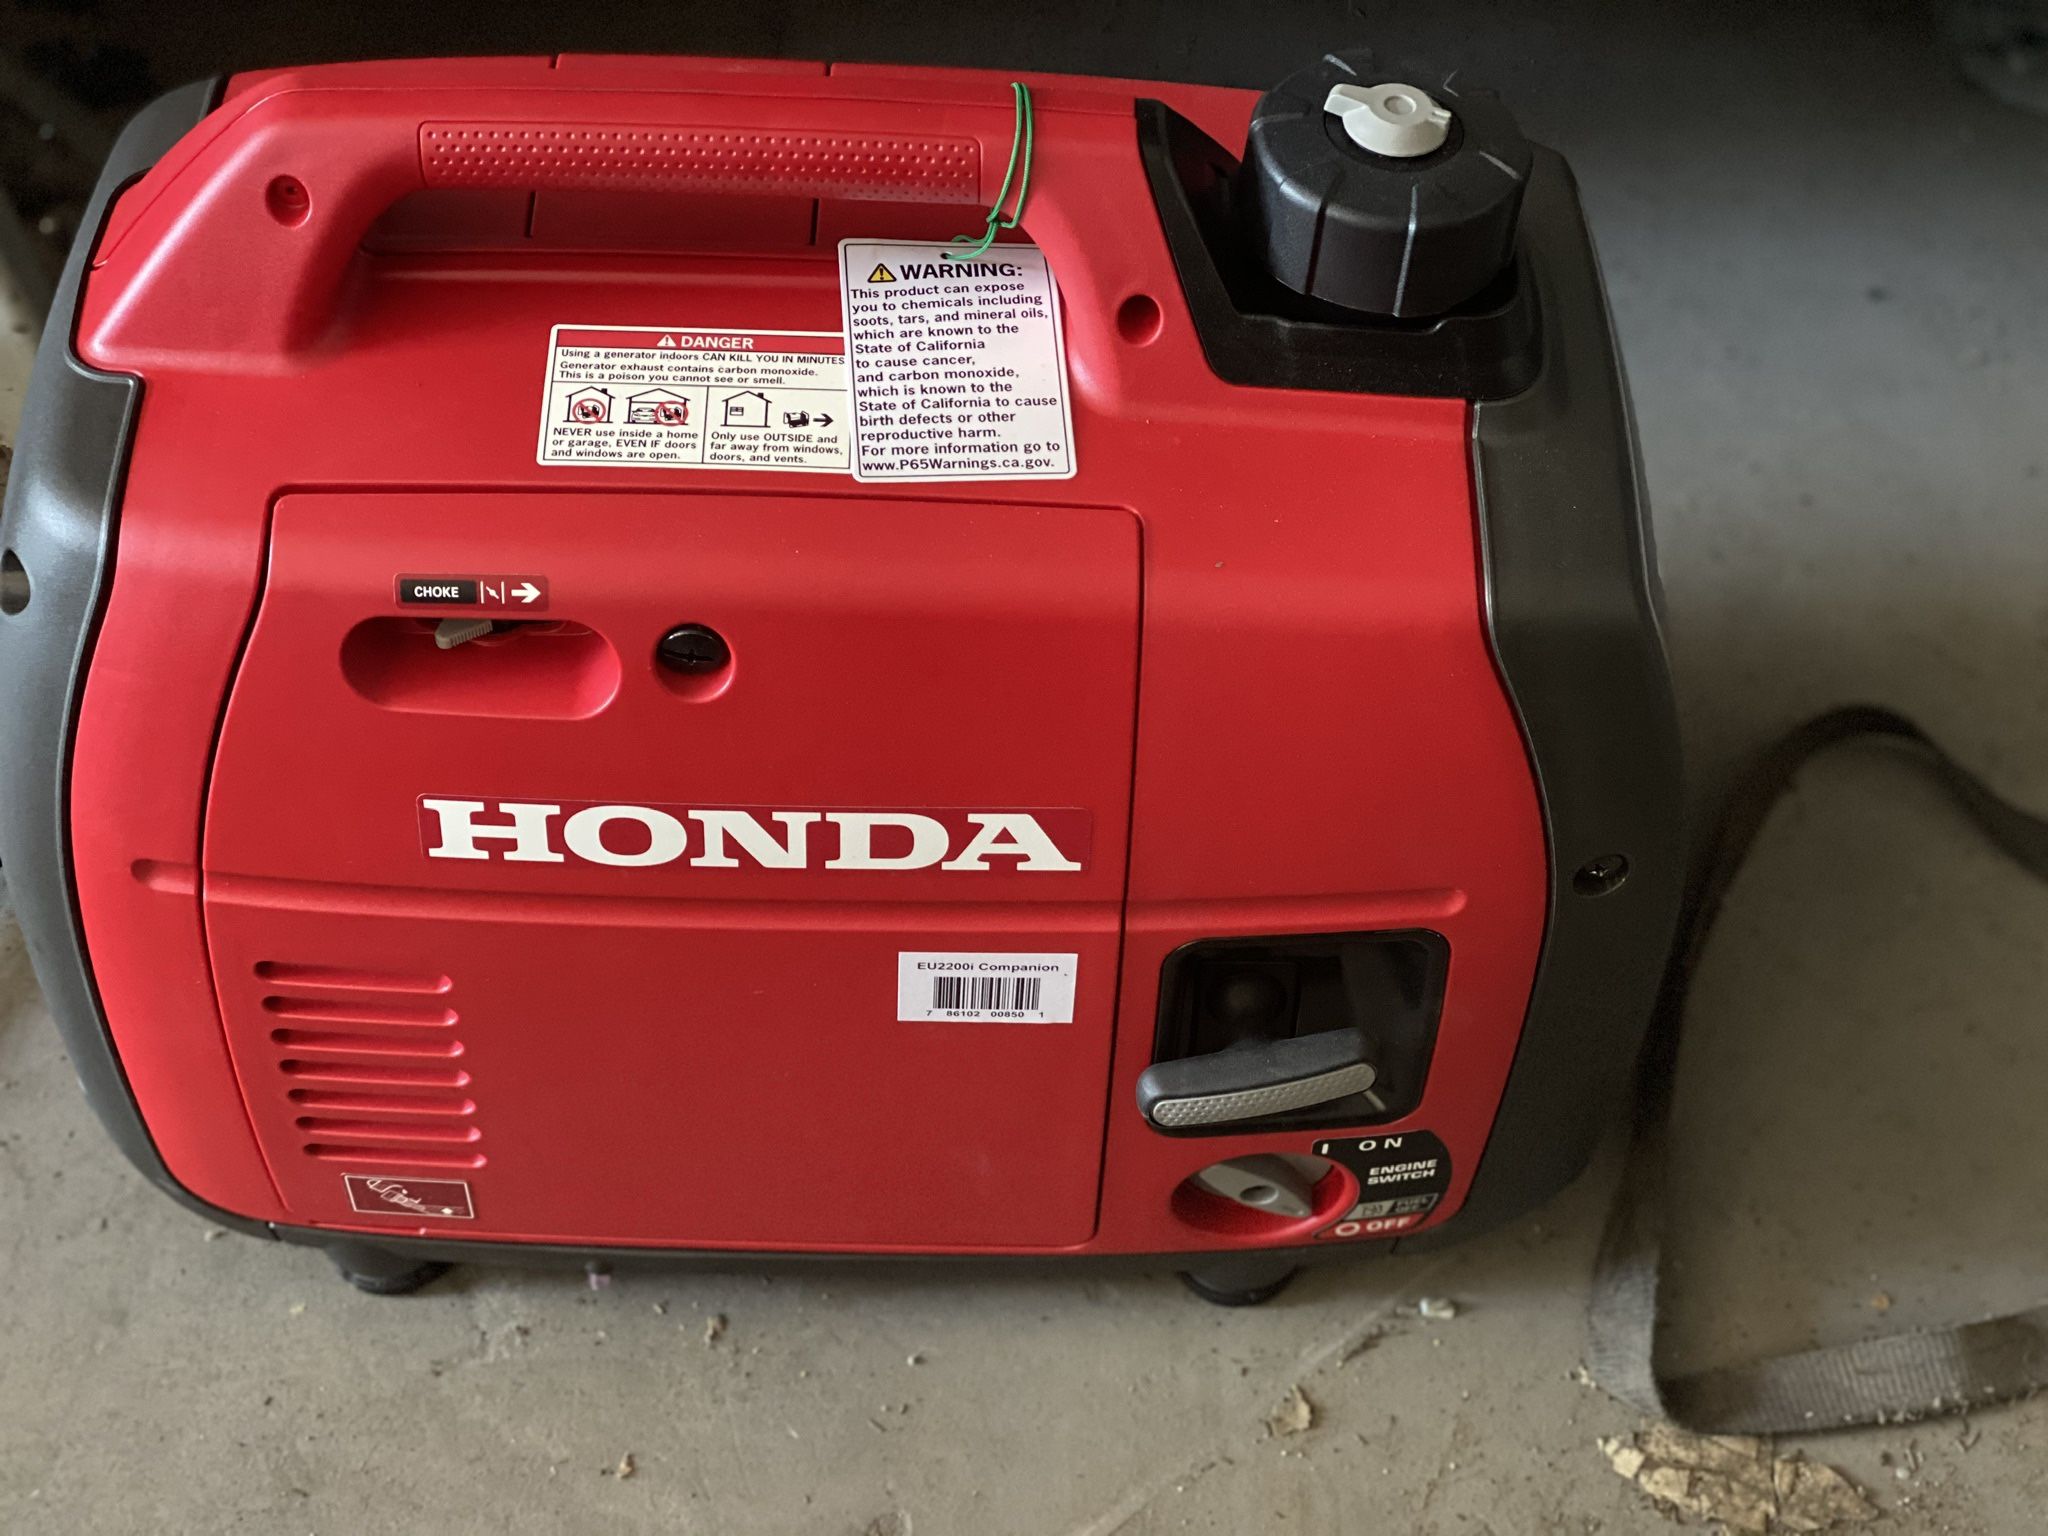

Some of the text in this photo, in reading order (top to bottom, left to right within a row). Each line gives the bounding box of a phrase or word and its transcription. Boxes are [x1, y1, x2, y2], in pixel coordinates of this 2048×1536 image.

[900, 263, 1022, 280] WARNING:
[851, 283, 1024, 299] This product can expose
[852, 294, 1042, 314] you to chemicals including
[853, 308, 1048, 326] soots, tars, and mineral oils,
[854, 324, 1018, 340] which are known to the
[680, 335, 754, 349] DANGER
[855, 339, 985, 354] State of California
[561, 349, 590, 358] Using
[604, 350, 656, 360] generator
[660, 351, 699, 360] indoors
[729, 354, 752, 362] KILL
[856, 356, 975, 368] to cause cancer,
[560, 361, 616, 370] Generator
[668, 365, 714, 373] contains
[718, 365, 758, 374] carbon
[761, 367, 818, 376] monoxide.
[858, 367, 1019, 382] and carbon monoxide,
[609, 372, 645, 381] poison
[858, 382, 1012, 397] which is known to the
[859, 397, 1057, 411] State of California to cause
[860, 411, 1016, 426] birth defects or other
[553, 428, 592, 436] NEVER
[619, 429, 652, 438] inside
[667, 430, 698, 439] home
[711, 431, 736, 440] Only
[764, 433, 813, 443] OUTSIDE
[817, 435, 838, 444] and
[861, 428, 1001, 442] reproductive harm.
[616, 439, 647, 448] EVEN
[665, 441, 696, 449] doors
[710, 442, 843, 455] far away from windows,
[862, 441, 1060, 456] For more information go to
[551, 448, 572, 457] and
[576, 448, 622, 458] windows
[710, 452, 807, 463] doors, and vents.
[862, 458, 1054, 470] www.P65Warnings.ca.gov.
[414, 586, 459, 598] CHOKE
[423, 798, 1081, 871] HONDA
[917, 962, 1059, 973] EU2200i Companion
[1359, 1137, 1402, 1151] ON
[1369, 1159, 1438, 1176] ENGINE
[1367, 1169, 1436, 1185] SWITCH
[1366, 1216, 1411, 1232] OFF
